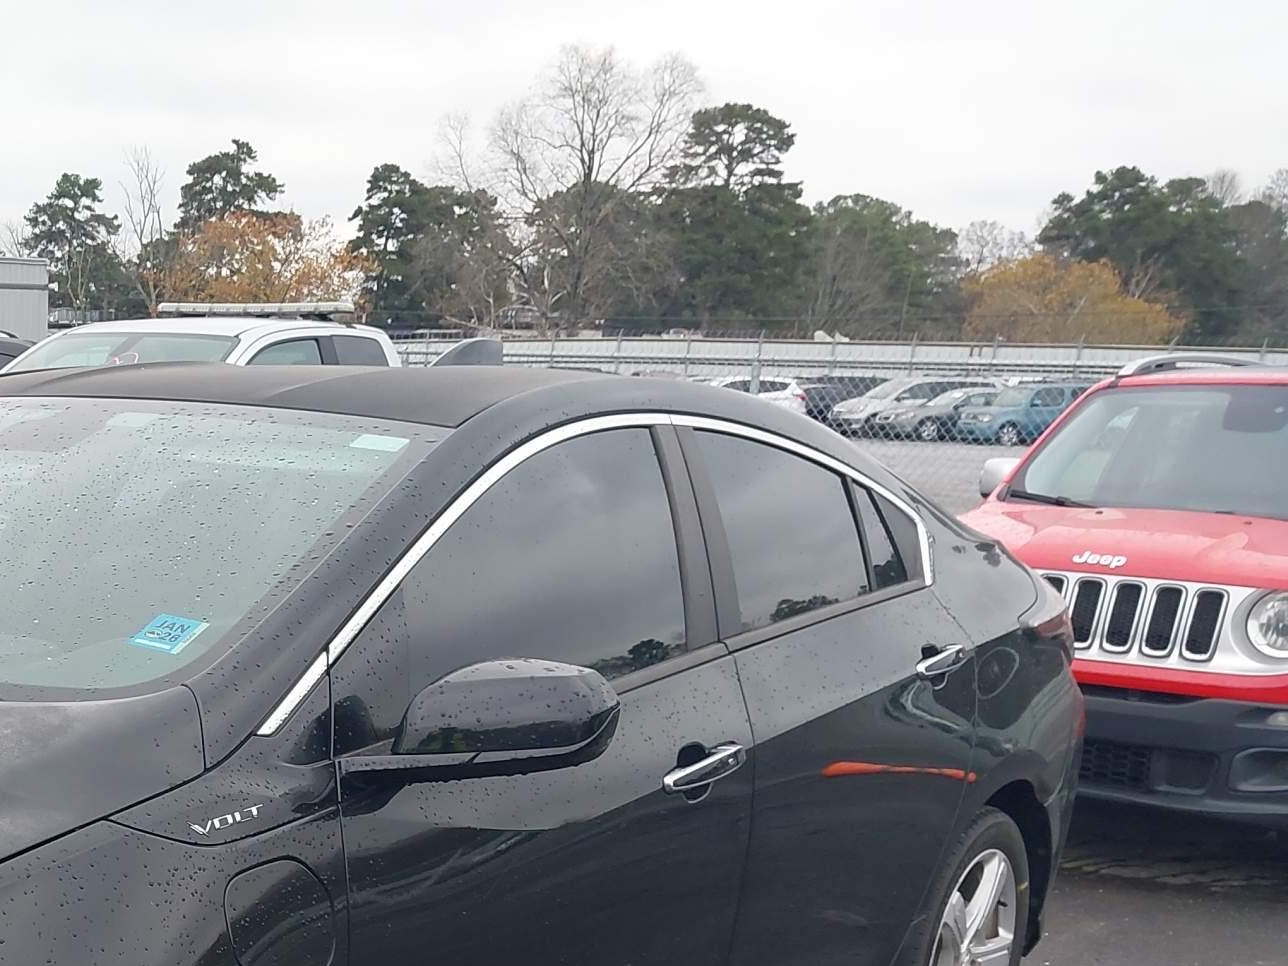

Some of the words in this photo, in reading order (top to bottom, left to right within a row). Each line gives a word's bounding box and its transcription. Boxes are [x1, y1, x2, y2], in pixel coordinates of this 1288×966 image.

[1072, 550, 1128, 569] Jeep
[153, 620, 191, 634] JAN
[187, 803, 264, 837] VOLT
